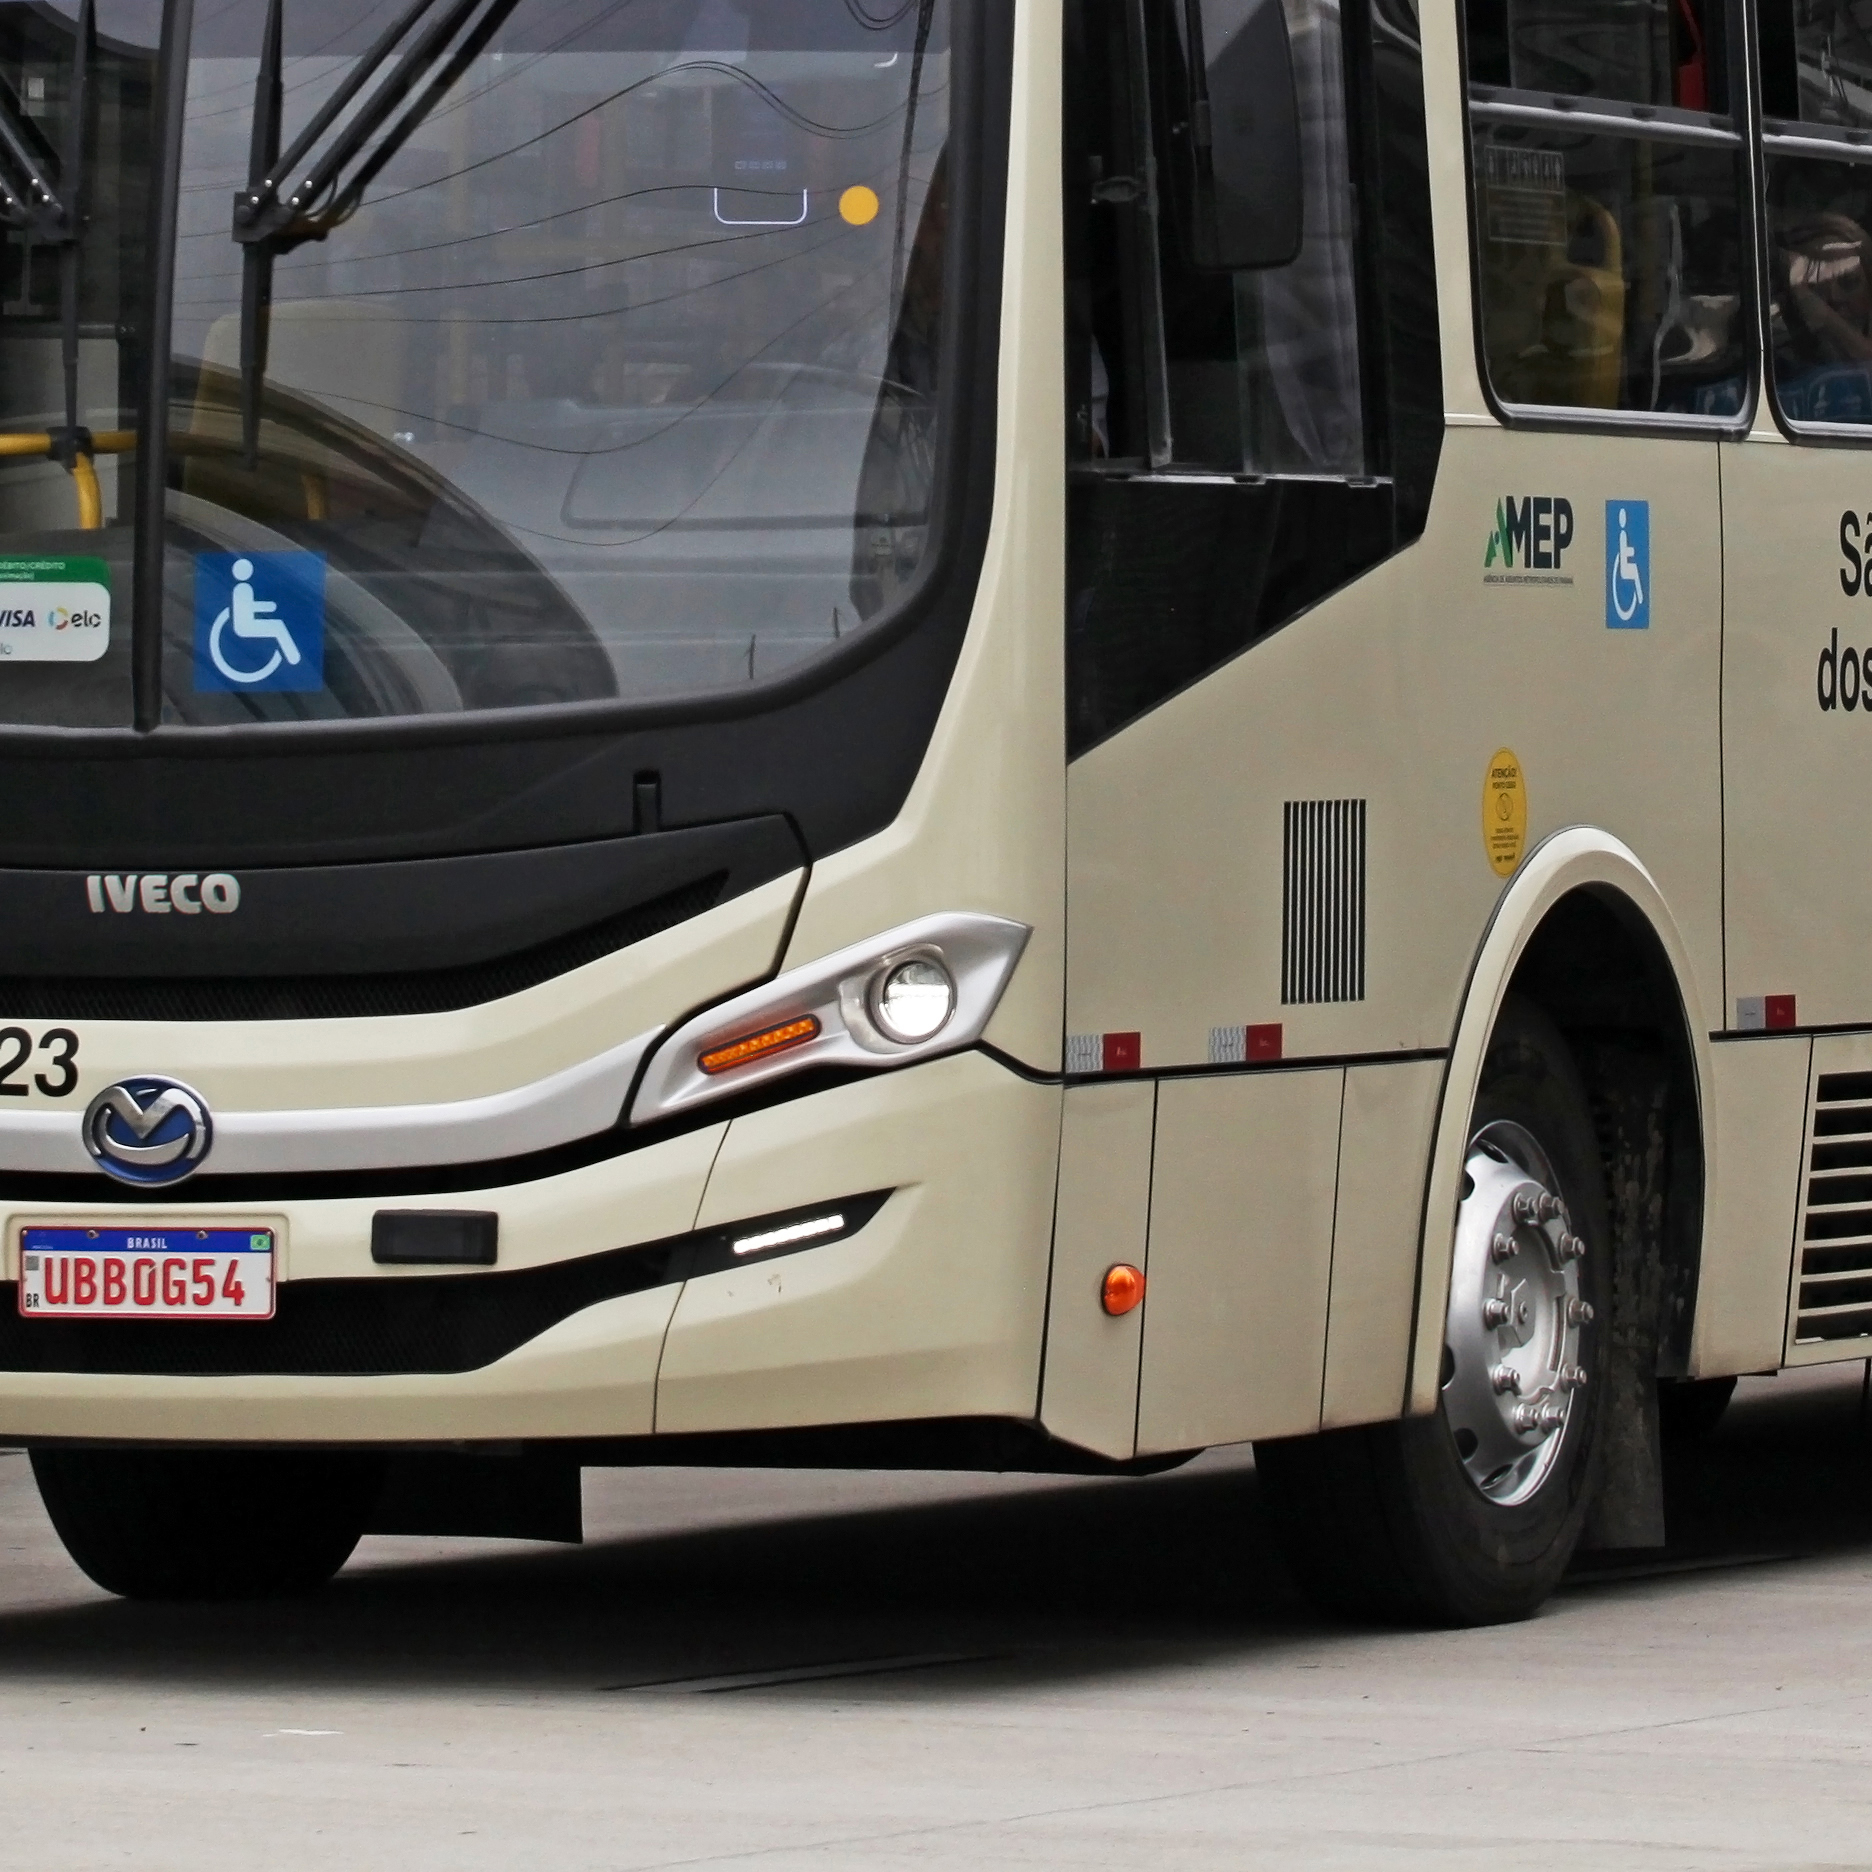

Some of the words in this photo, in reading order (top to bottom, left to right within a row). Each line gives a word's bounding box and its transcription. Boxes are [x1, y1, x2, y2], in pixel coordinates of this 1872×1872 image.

[1484, 496, 1574, 569] AMEP
[71, 609, 101, 628] elo
[86, 873, 242, 914] IVECO
[127, 1237, 168, 1249] BRASIL
[25, 1292, 40, 1308] BR
